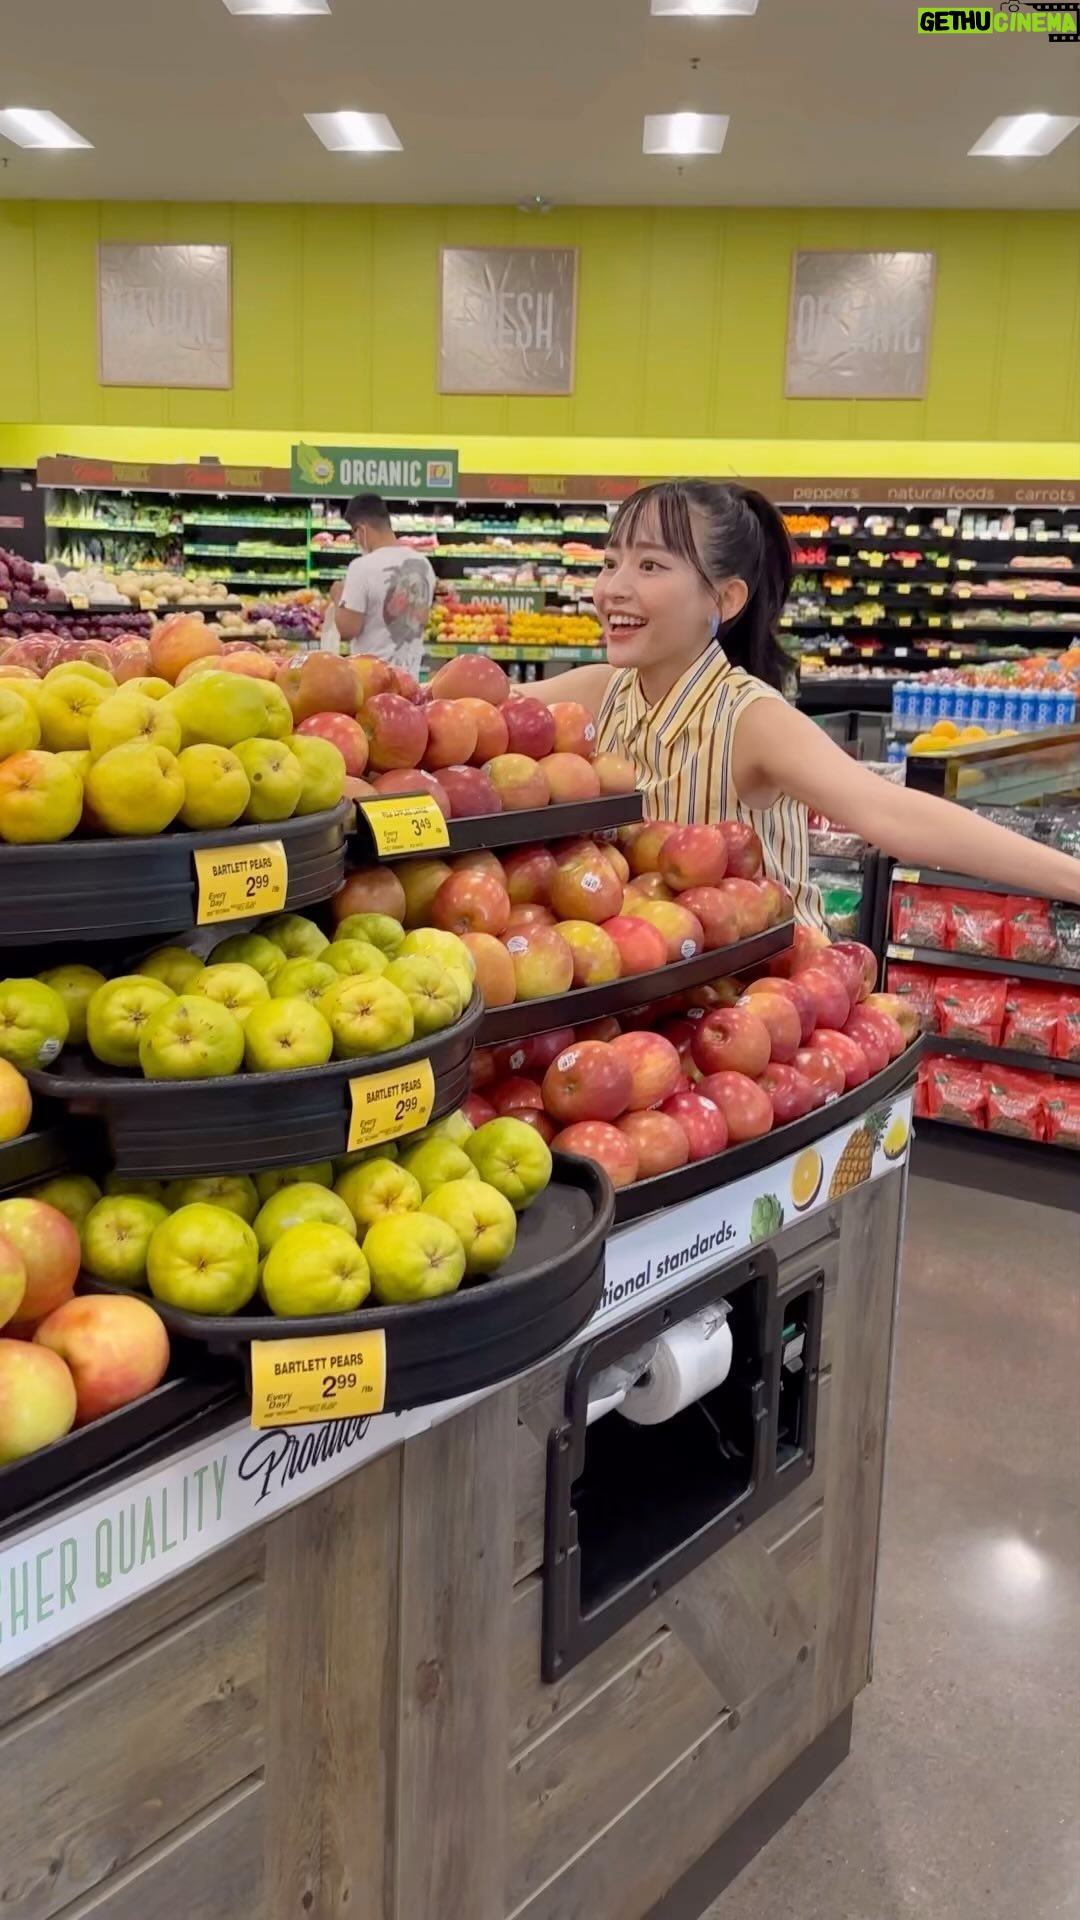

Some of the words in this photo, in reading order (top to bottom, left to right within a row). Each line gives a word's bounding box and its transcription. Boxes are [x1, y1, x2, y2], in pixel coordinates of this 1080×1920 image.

[340, 459, 421, 487] ORGANIC
[793, 487, 860, 502] peppers
[887, 487, 946, 501] natural
[950, 485, 995, 502] foods
[1015, 488, 1076, 502] carrots
[212, 860, 248, 876] BARTLETT
[249, 857, 273, 871] PEARS
[246, 874, 270, 897] 299
[208, 892, 227, 901] Every
[366, 1085, 399, 1104] BARTLETT
[400, 1078, 422, 1094] PEARS
[394, 1096, 418, 1121] 299
[360, 1118, 377, 1128] Every
[656, 1220, 737, 1279] standards.
[274, 1357, 328, 1376] BARTLETT
[329, 1353, 364, 1369] PEARS
[322, 1373, 357, 1398] 299
[266, 1392, 293, 1402] Every
[268, 1399, 290, 1410] Day!
[0, 1538, 78, 1643] HER
[95, 1455, 228, 1588] QUALITY
